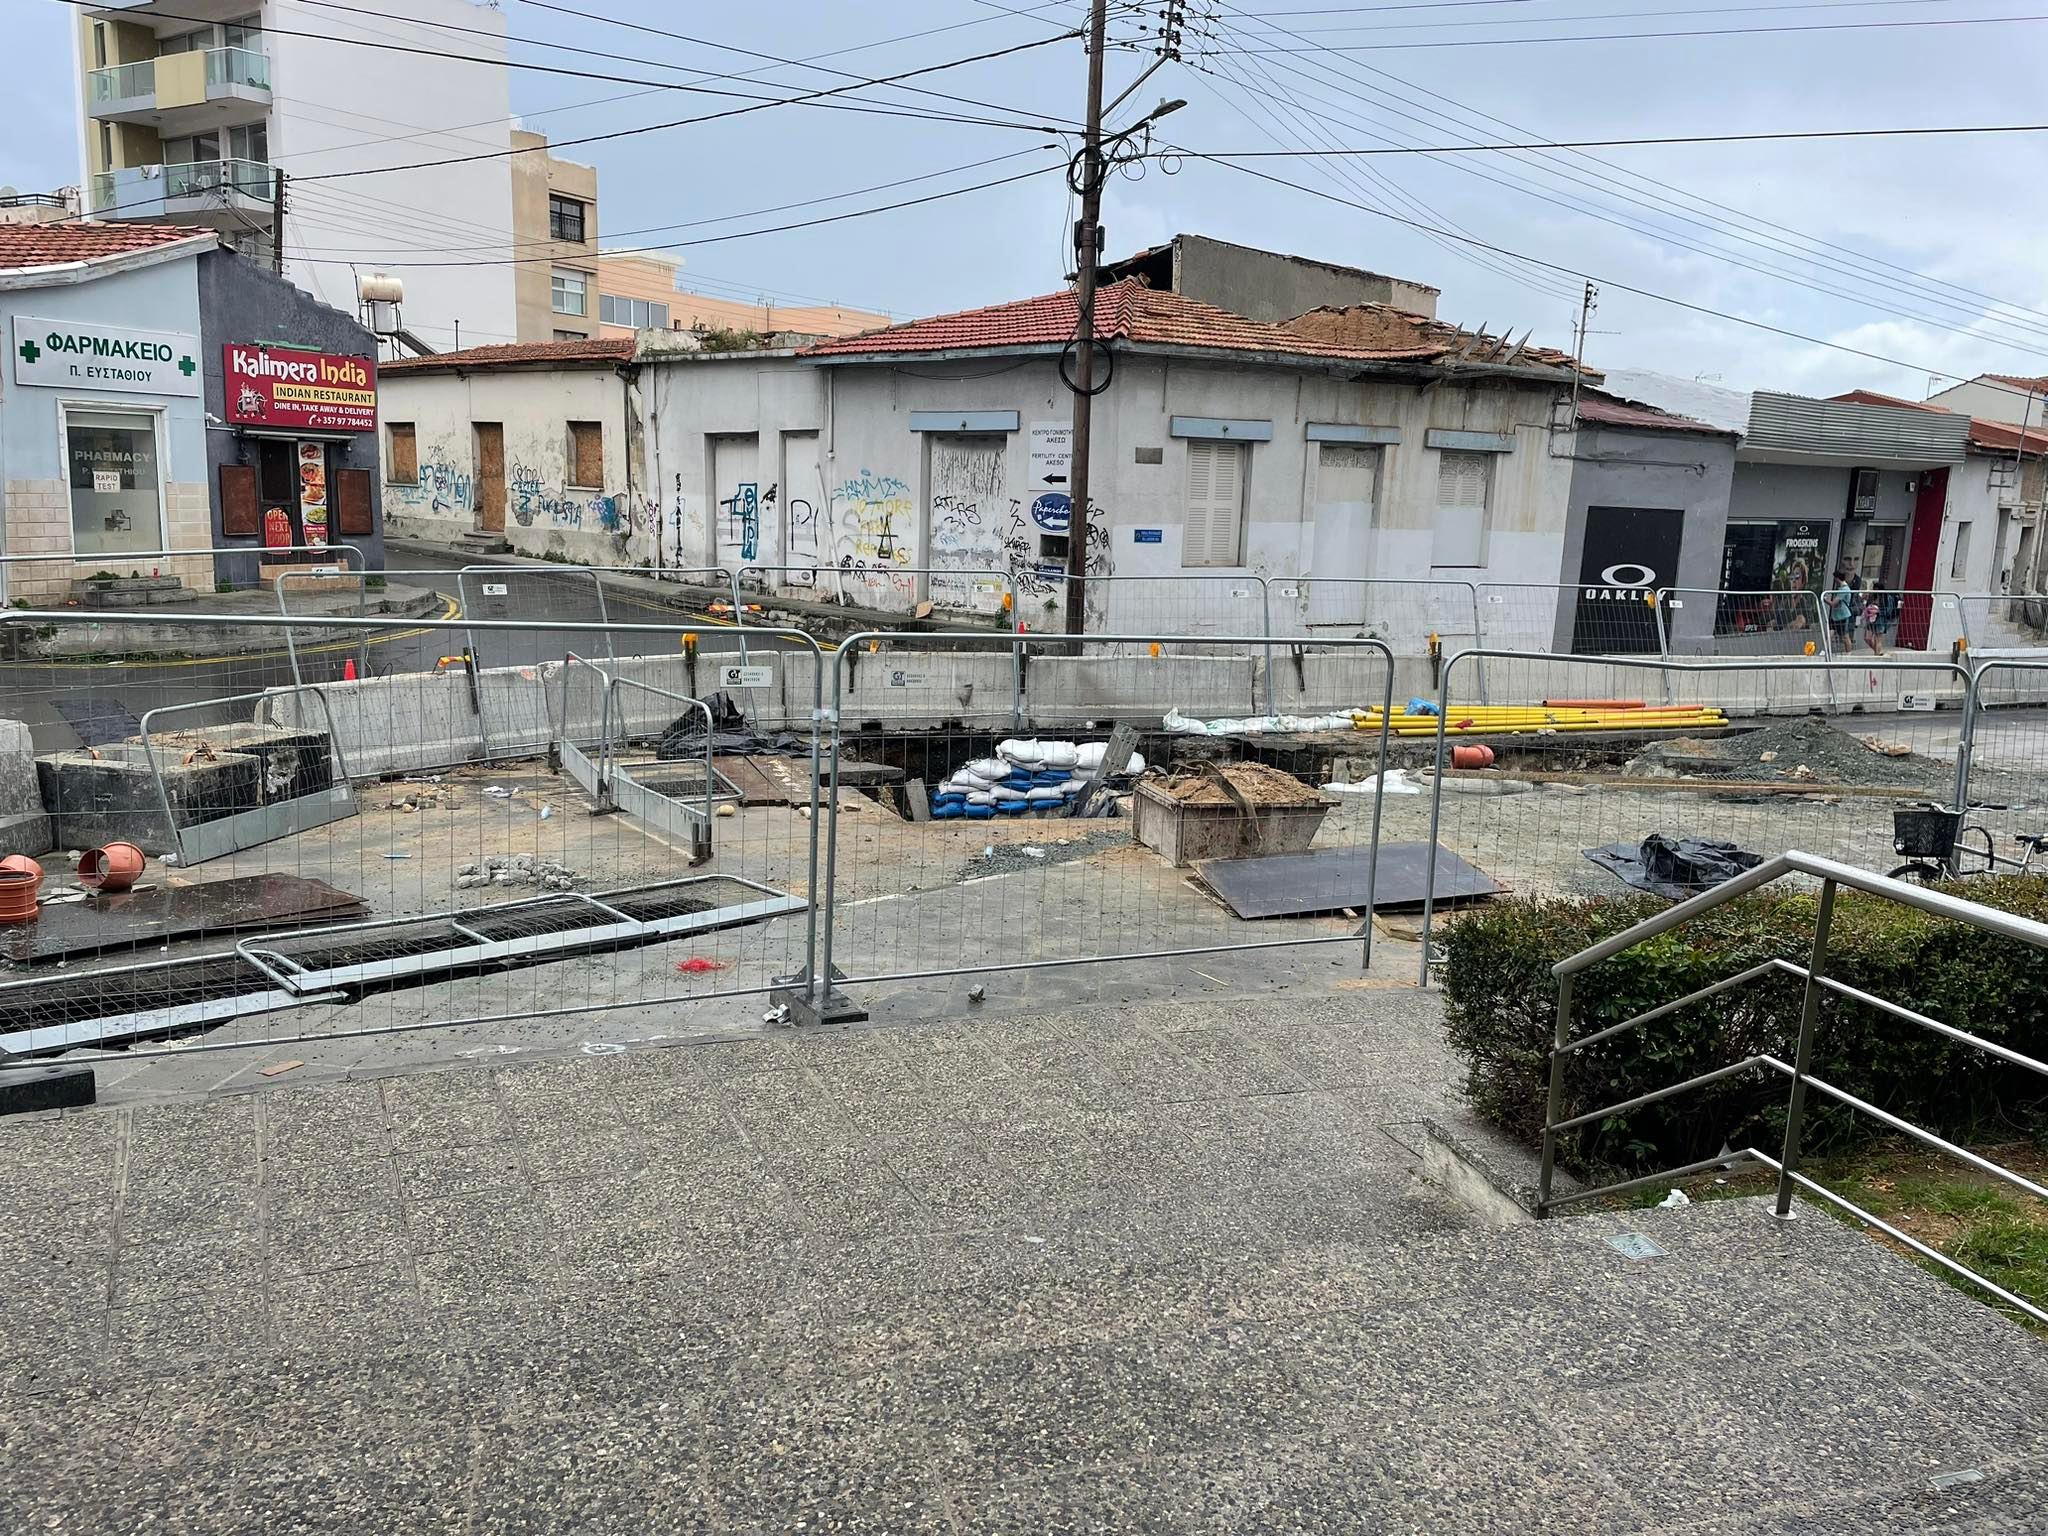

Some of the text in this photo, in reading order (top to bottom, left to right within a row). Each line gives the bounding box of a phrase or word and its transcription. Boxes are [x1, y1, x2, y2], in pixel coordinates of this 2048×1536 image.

[46, 332, 173, 362] ΦΑΡΜΑΚΕΙΟ
[70, 365, 152, 382] Π. ΕΥΣΤΑΘΙΟΥ
[233, 350, 366, 386] Kalimera India
[276, 387, 372, 403] INDIAN RESTAURANT
[275, 402, 291, 411] DINE
[302, 404, 318, 413] TAKE
[320, 406, 337, 414] AWAY
[345, 408, 374, 416] DELIVERY
[323, 416, 336, 425] 357
[337, 417, 346, 426] 97
[348, 418, 373, 427] 784452
[74, 451, 151, 463] PHARMACY
[95, 474, 118, 482] RAPID
[269, 521, 289, 533] NEXT
[1785, 538, 1819, 548] FROGSKINS
